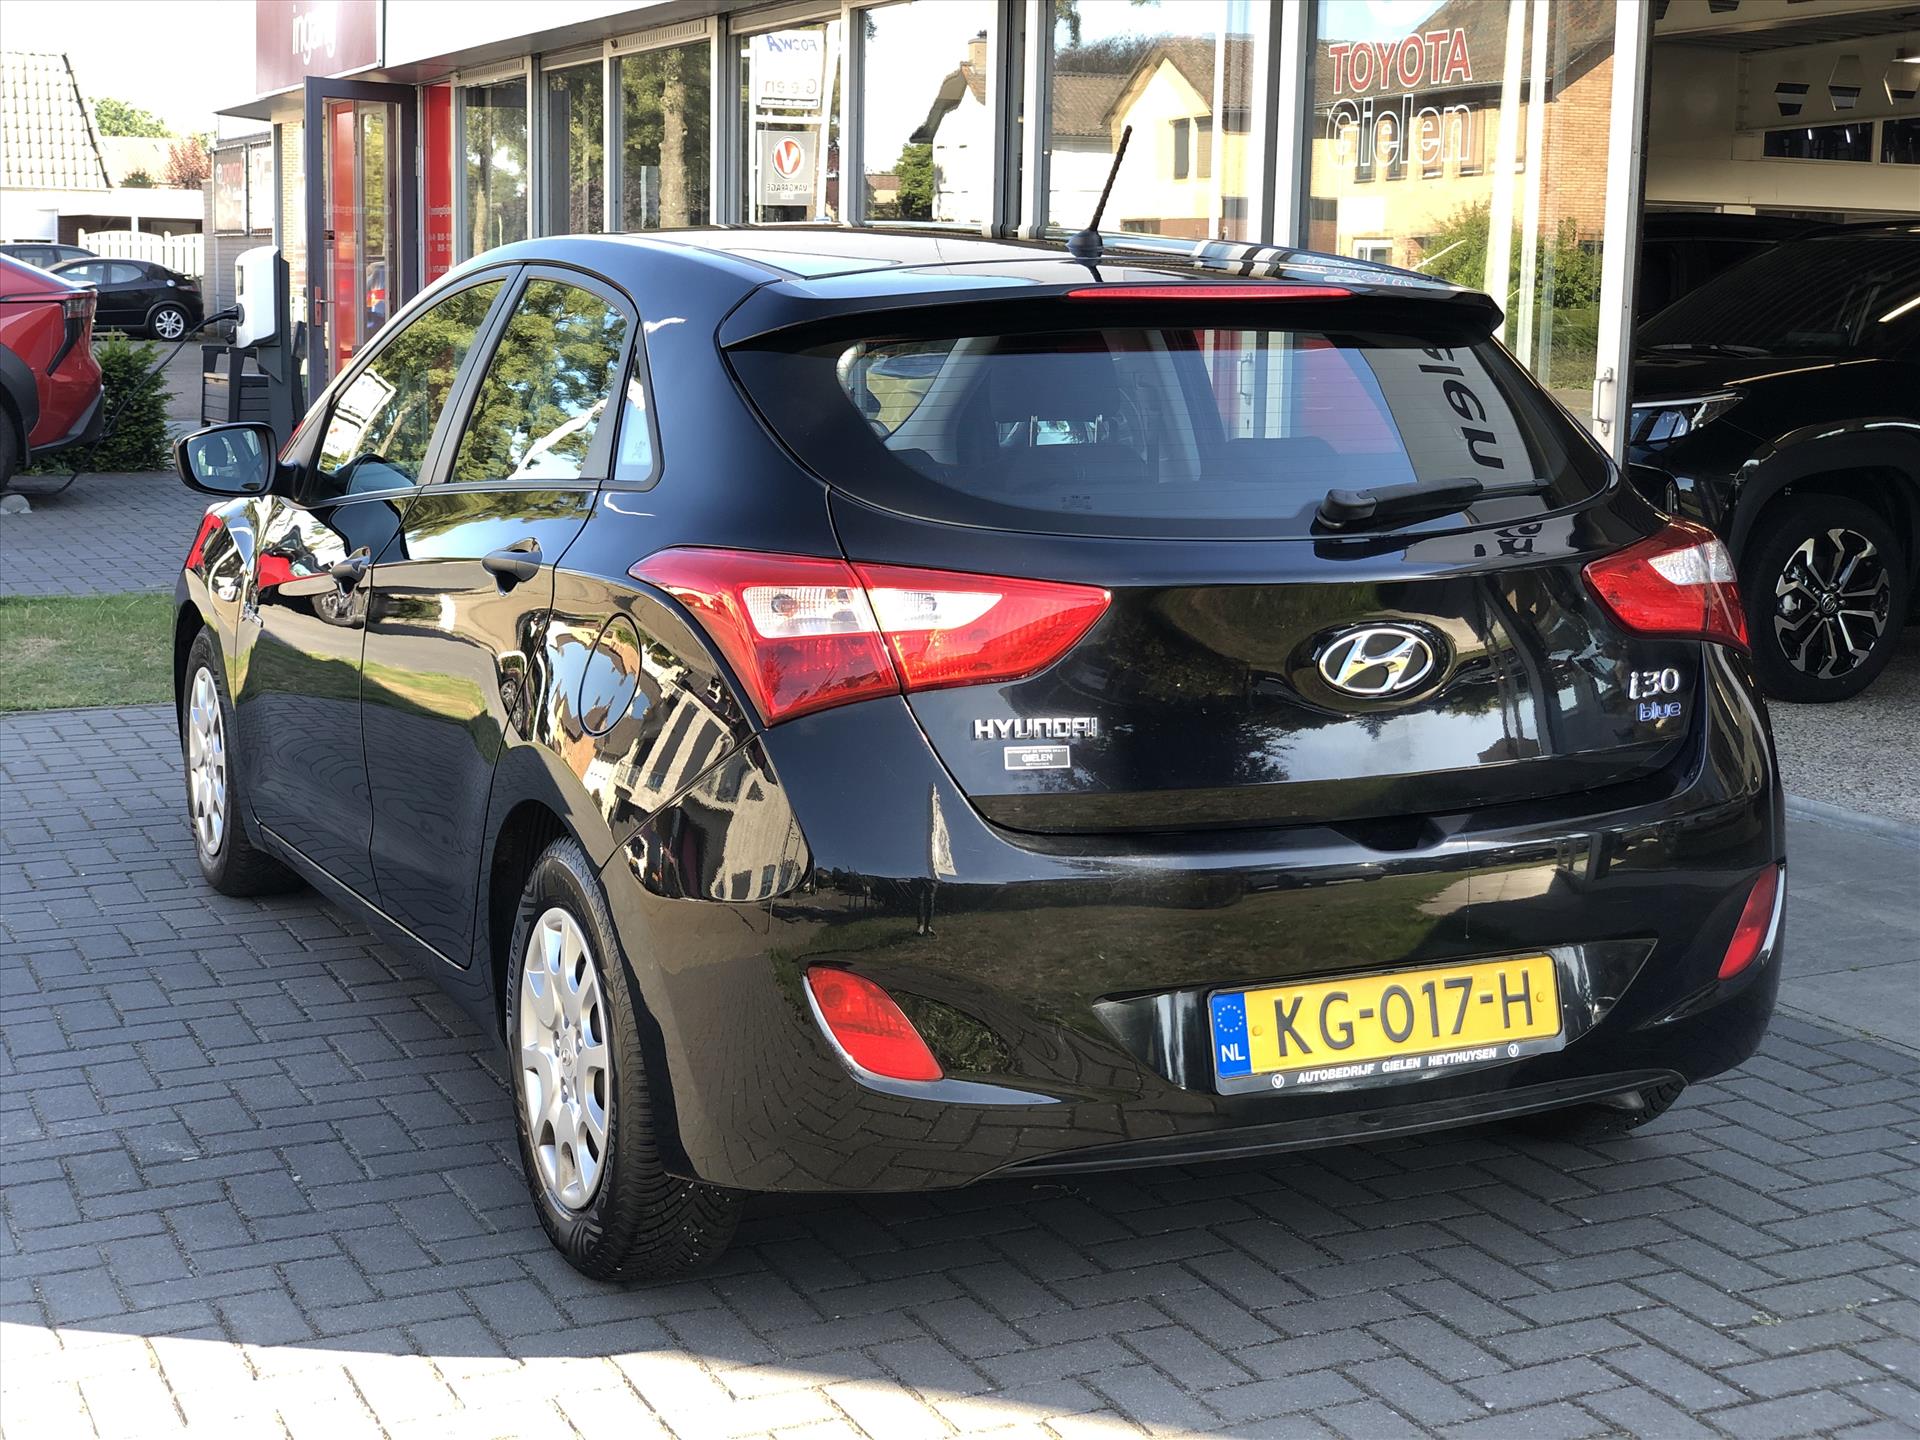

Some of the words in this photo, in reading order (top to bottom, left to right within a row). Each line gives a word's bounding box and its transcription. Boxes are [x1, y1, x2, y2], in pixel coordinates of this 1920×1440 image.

[1328, 27, 1473, 95] TOYOTA
[1326, 93, 1472, 167] Gielen
[1629, 668, 1680, 700] i30
[974, 716, 1098, 739] HYUNDAI
[1639, 701, 1682, 721] blue
[1273, 970, 1533, 1058] KG-017-H
[1221, 1043, 1246, 1062] NL
[1297, 1063, 1375, 1084] AUTOBEDRIJF
[1382, 1057, 1421, 1073] GIELEN
[1428, 1047, 1497, 1067] HEYTHUYSEN
